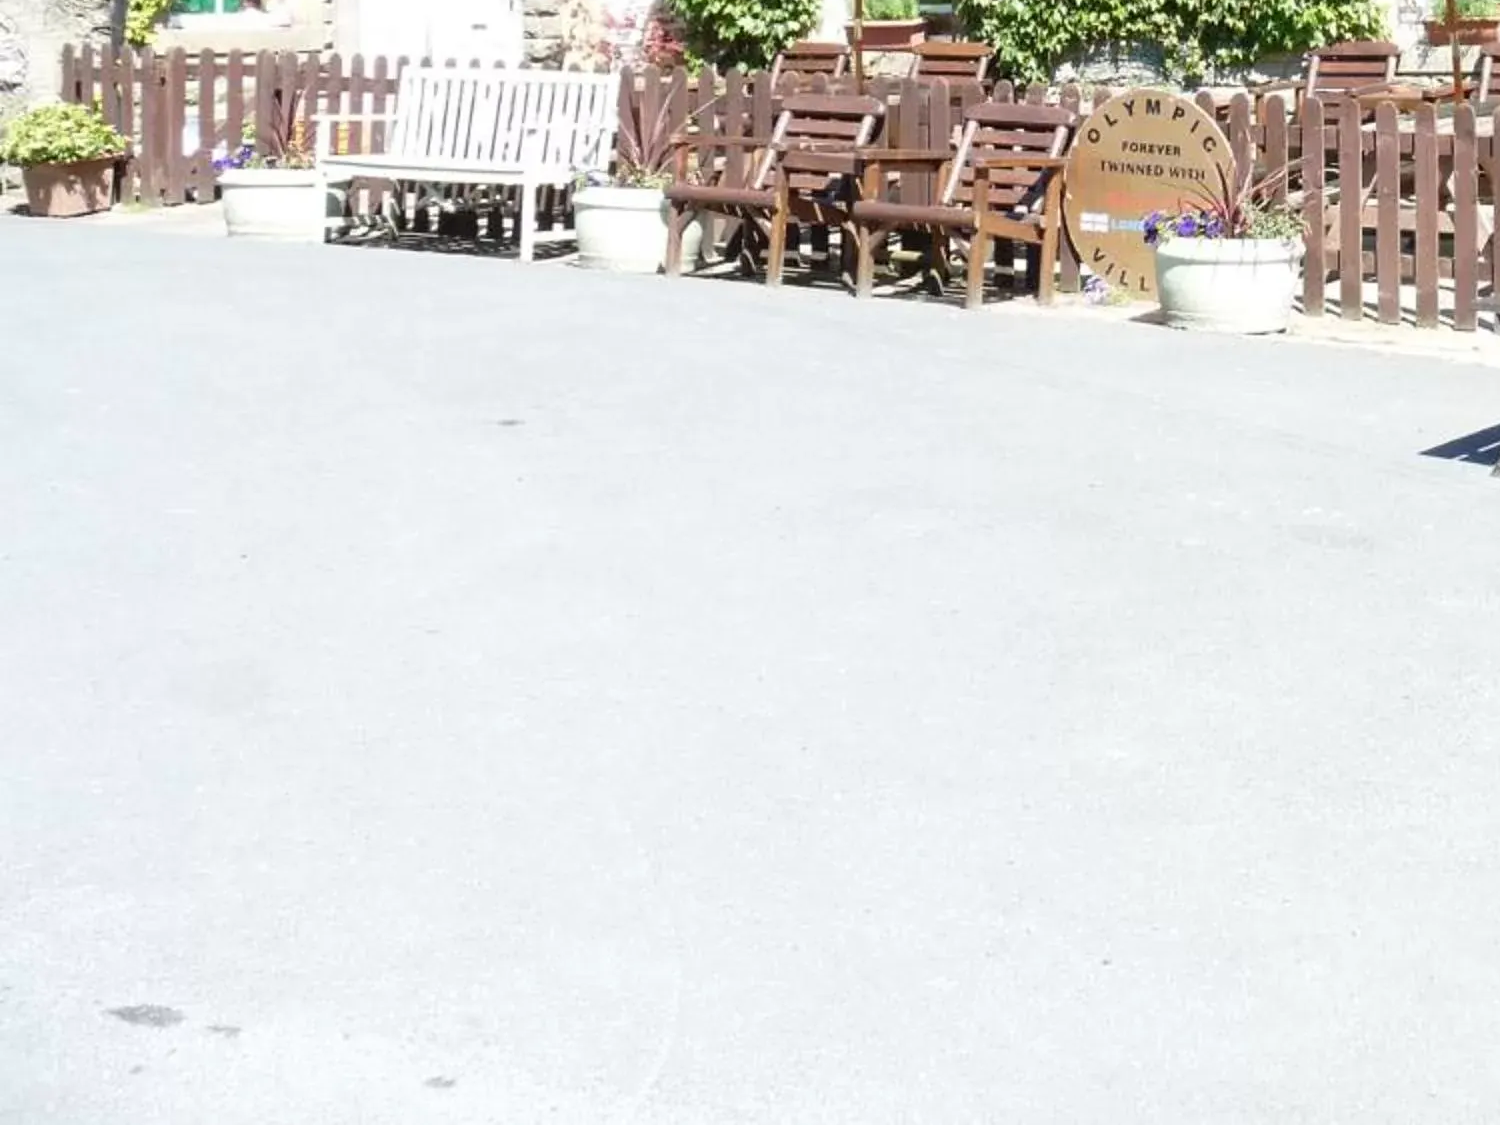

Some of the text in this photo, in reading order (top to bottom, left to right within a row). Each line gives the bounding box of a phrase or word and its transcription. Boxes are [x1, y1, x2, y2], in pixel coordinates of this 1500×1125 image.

[1086, 98, 1218, 153] OLYMPIC
[1121, 140, 1181, 156] FOREVER
[1100, 160, 1206, 180] TWINNED WITH
[1092, 247, 1151, 292] VILL
